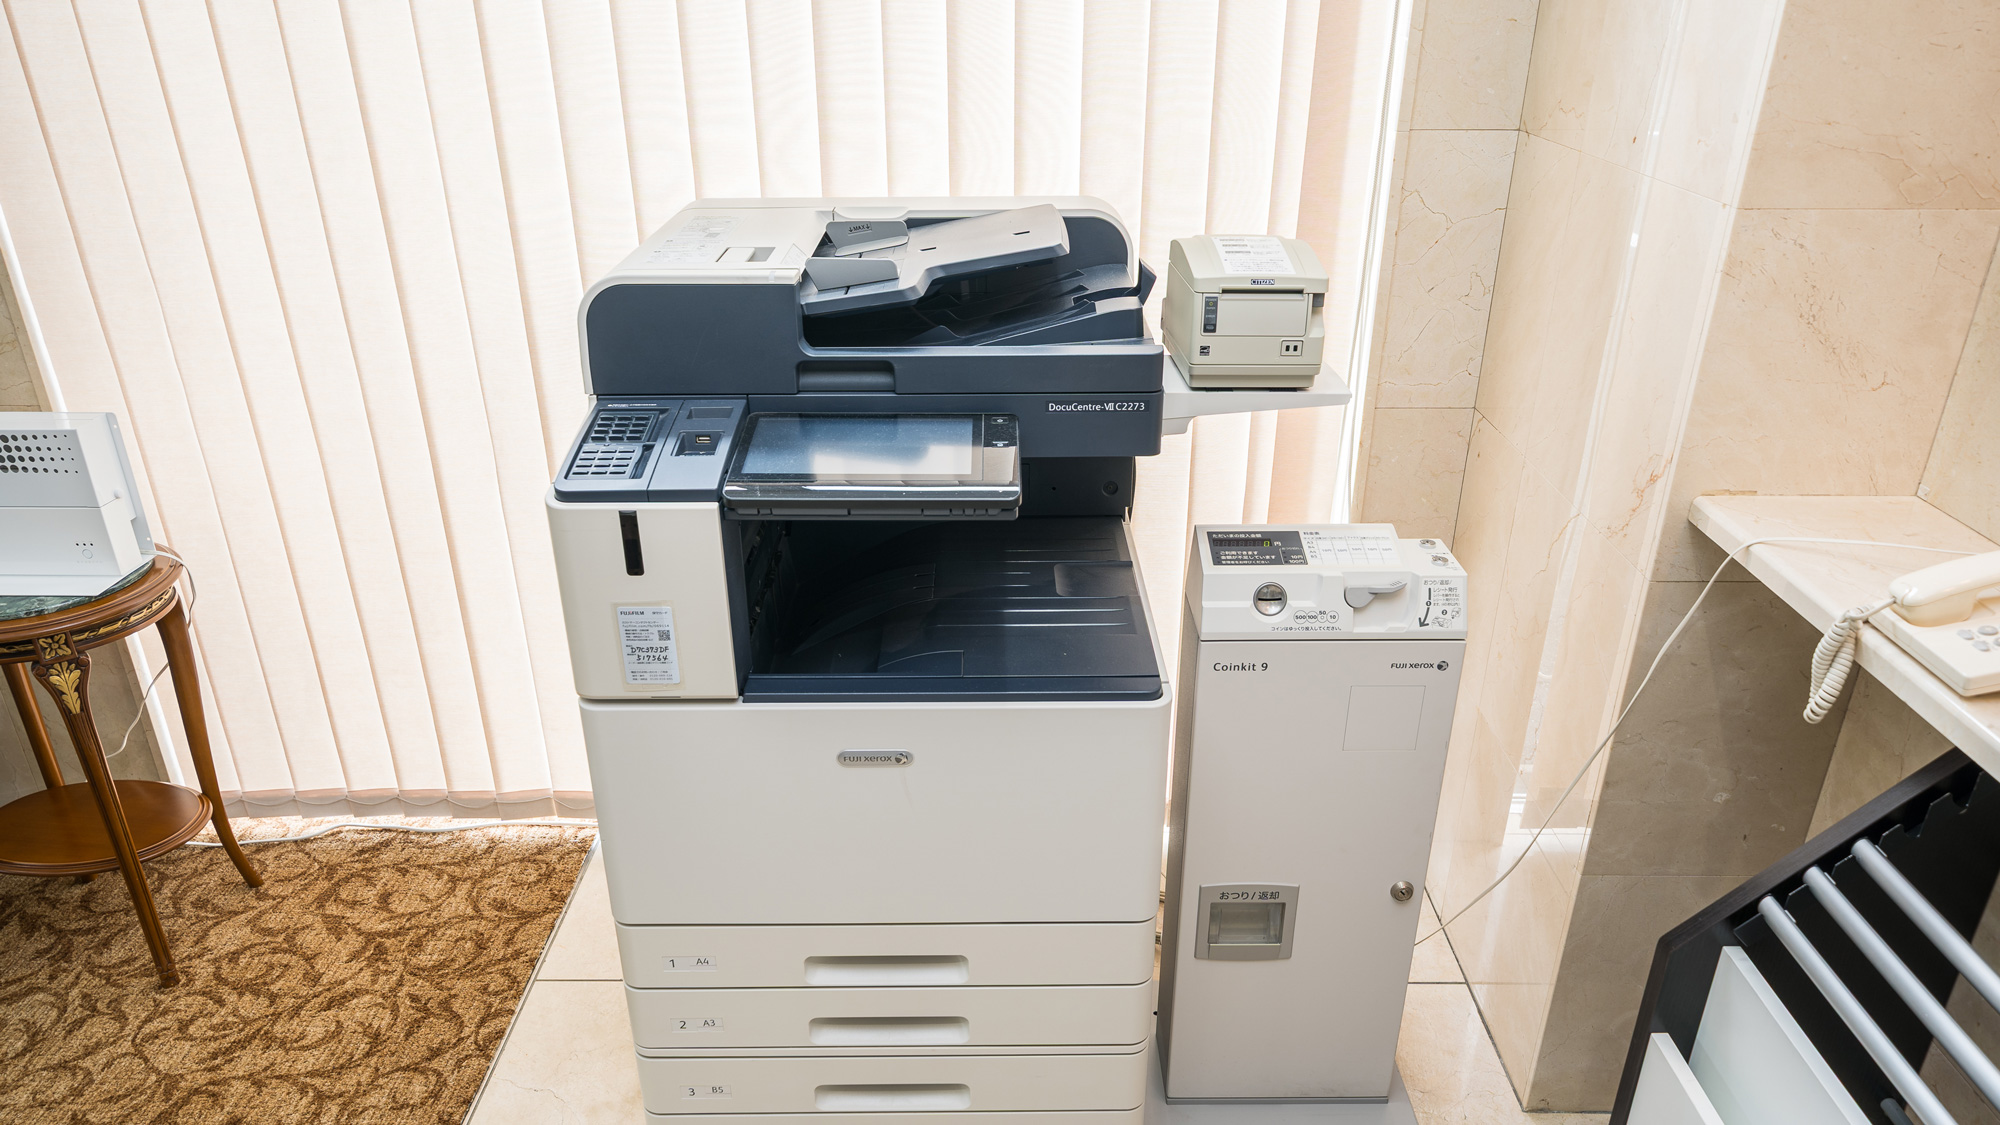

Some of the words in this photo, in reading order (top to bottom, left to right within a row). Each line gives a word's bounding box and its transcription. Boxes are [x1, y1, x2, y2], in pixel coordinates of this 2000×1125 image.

[1116, 402, 1145, 411] C2273
[1213, 662, 1256, 672] Coinkit
[1261, 662, 1268, 671] 9
[669, 959, 676, 968] 1
[679, 1020, 686, 1029] 2
[688, 1088, 695, 1096] 3
